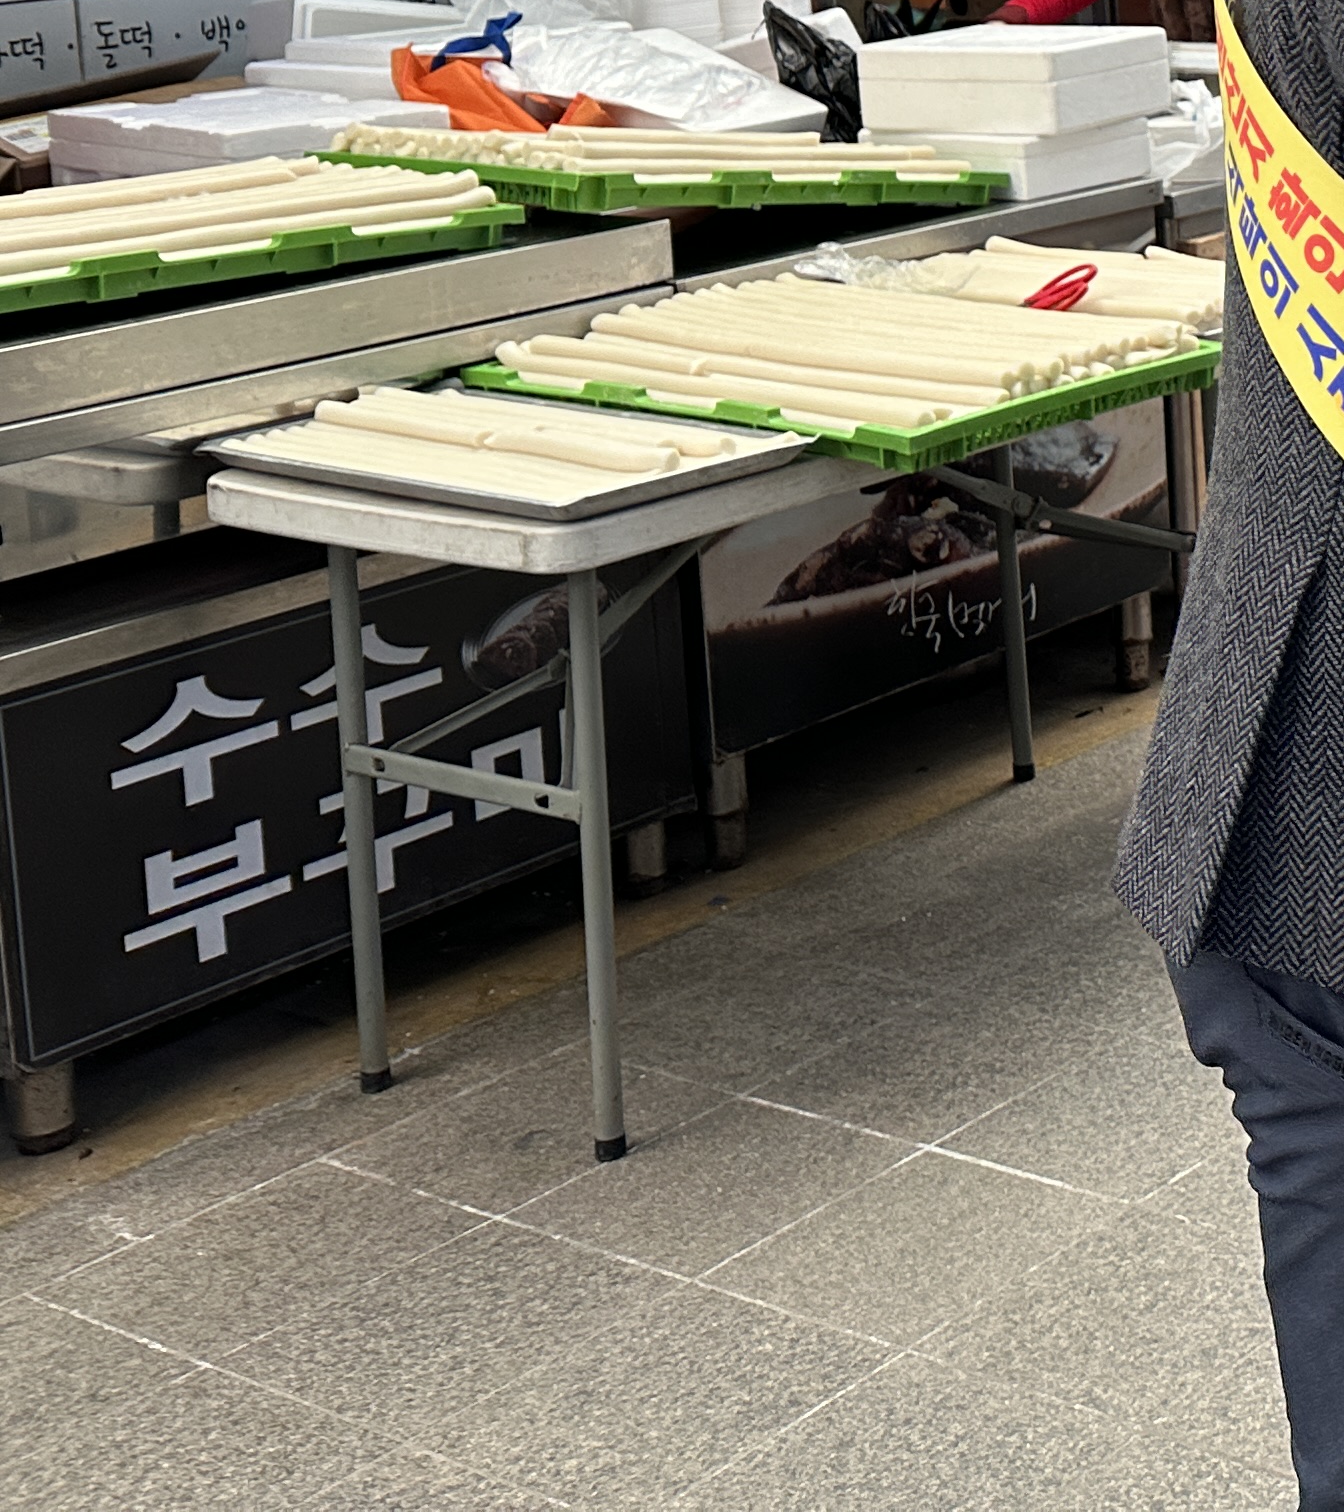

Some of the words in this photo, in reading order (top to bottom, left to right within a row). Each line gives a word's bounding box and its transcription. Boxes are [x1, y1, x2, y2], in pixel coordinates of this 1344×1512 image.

[0, 31, 45, 72] 떡
[94, 19, 153, 69] 돌떡
[201, 14, 247, 52] 백
[110, 623, 444, 808] 수수
